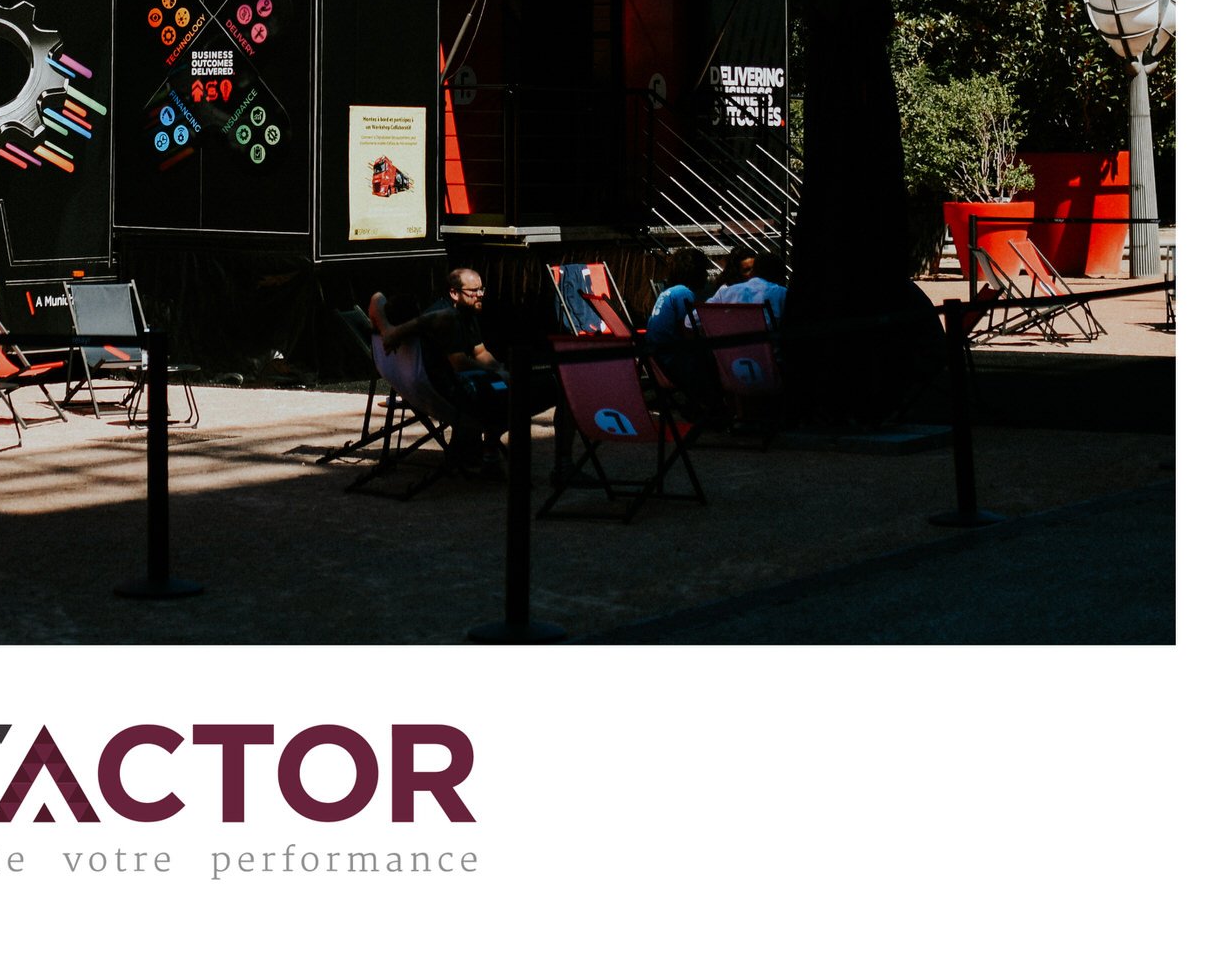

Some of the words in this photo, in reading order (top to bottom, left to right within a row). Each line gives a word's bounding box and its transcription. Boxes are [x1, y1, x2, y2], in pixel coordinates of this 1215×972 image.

[166, 13, 207, 66] TECHNOLOGY
[225, 19, 255, 56] DELIVERY
[191, 51, 233, 59] BUSINESS
[191, 59, 233, 67] OUTCOMES
[191, 67, 235, 76] DELIVERED.
[710, 66, 784, 87] DELIVERING
[168, 90, 202, 133] FINANCING
[221, 88, 258, 133] INSURANCE
[35, 295, 42, 307] A
